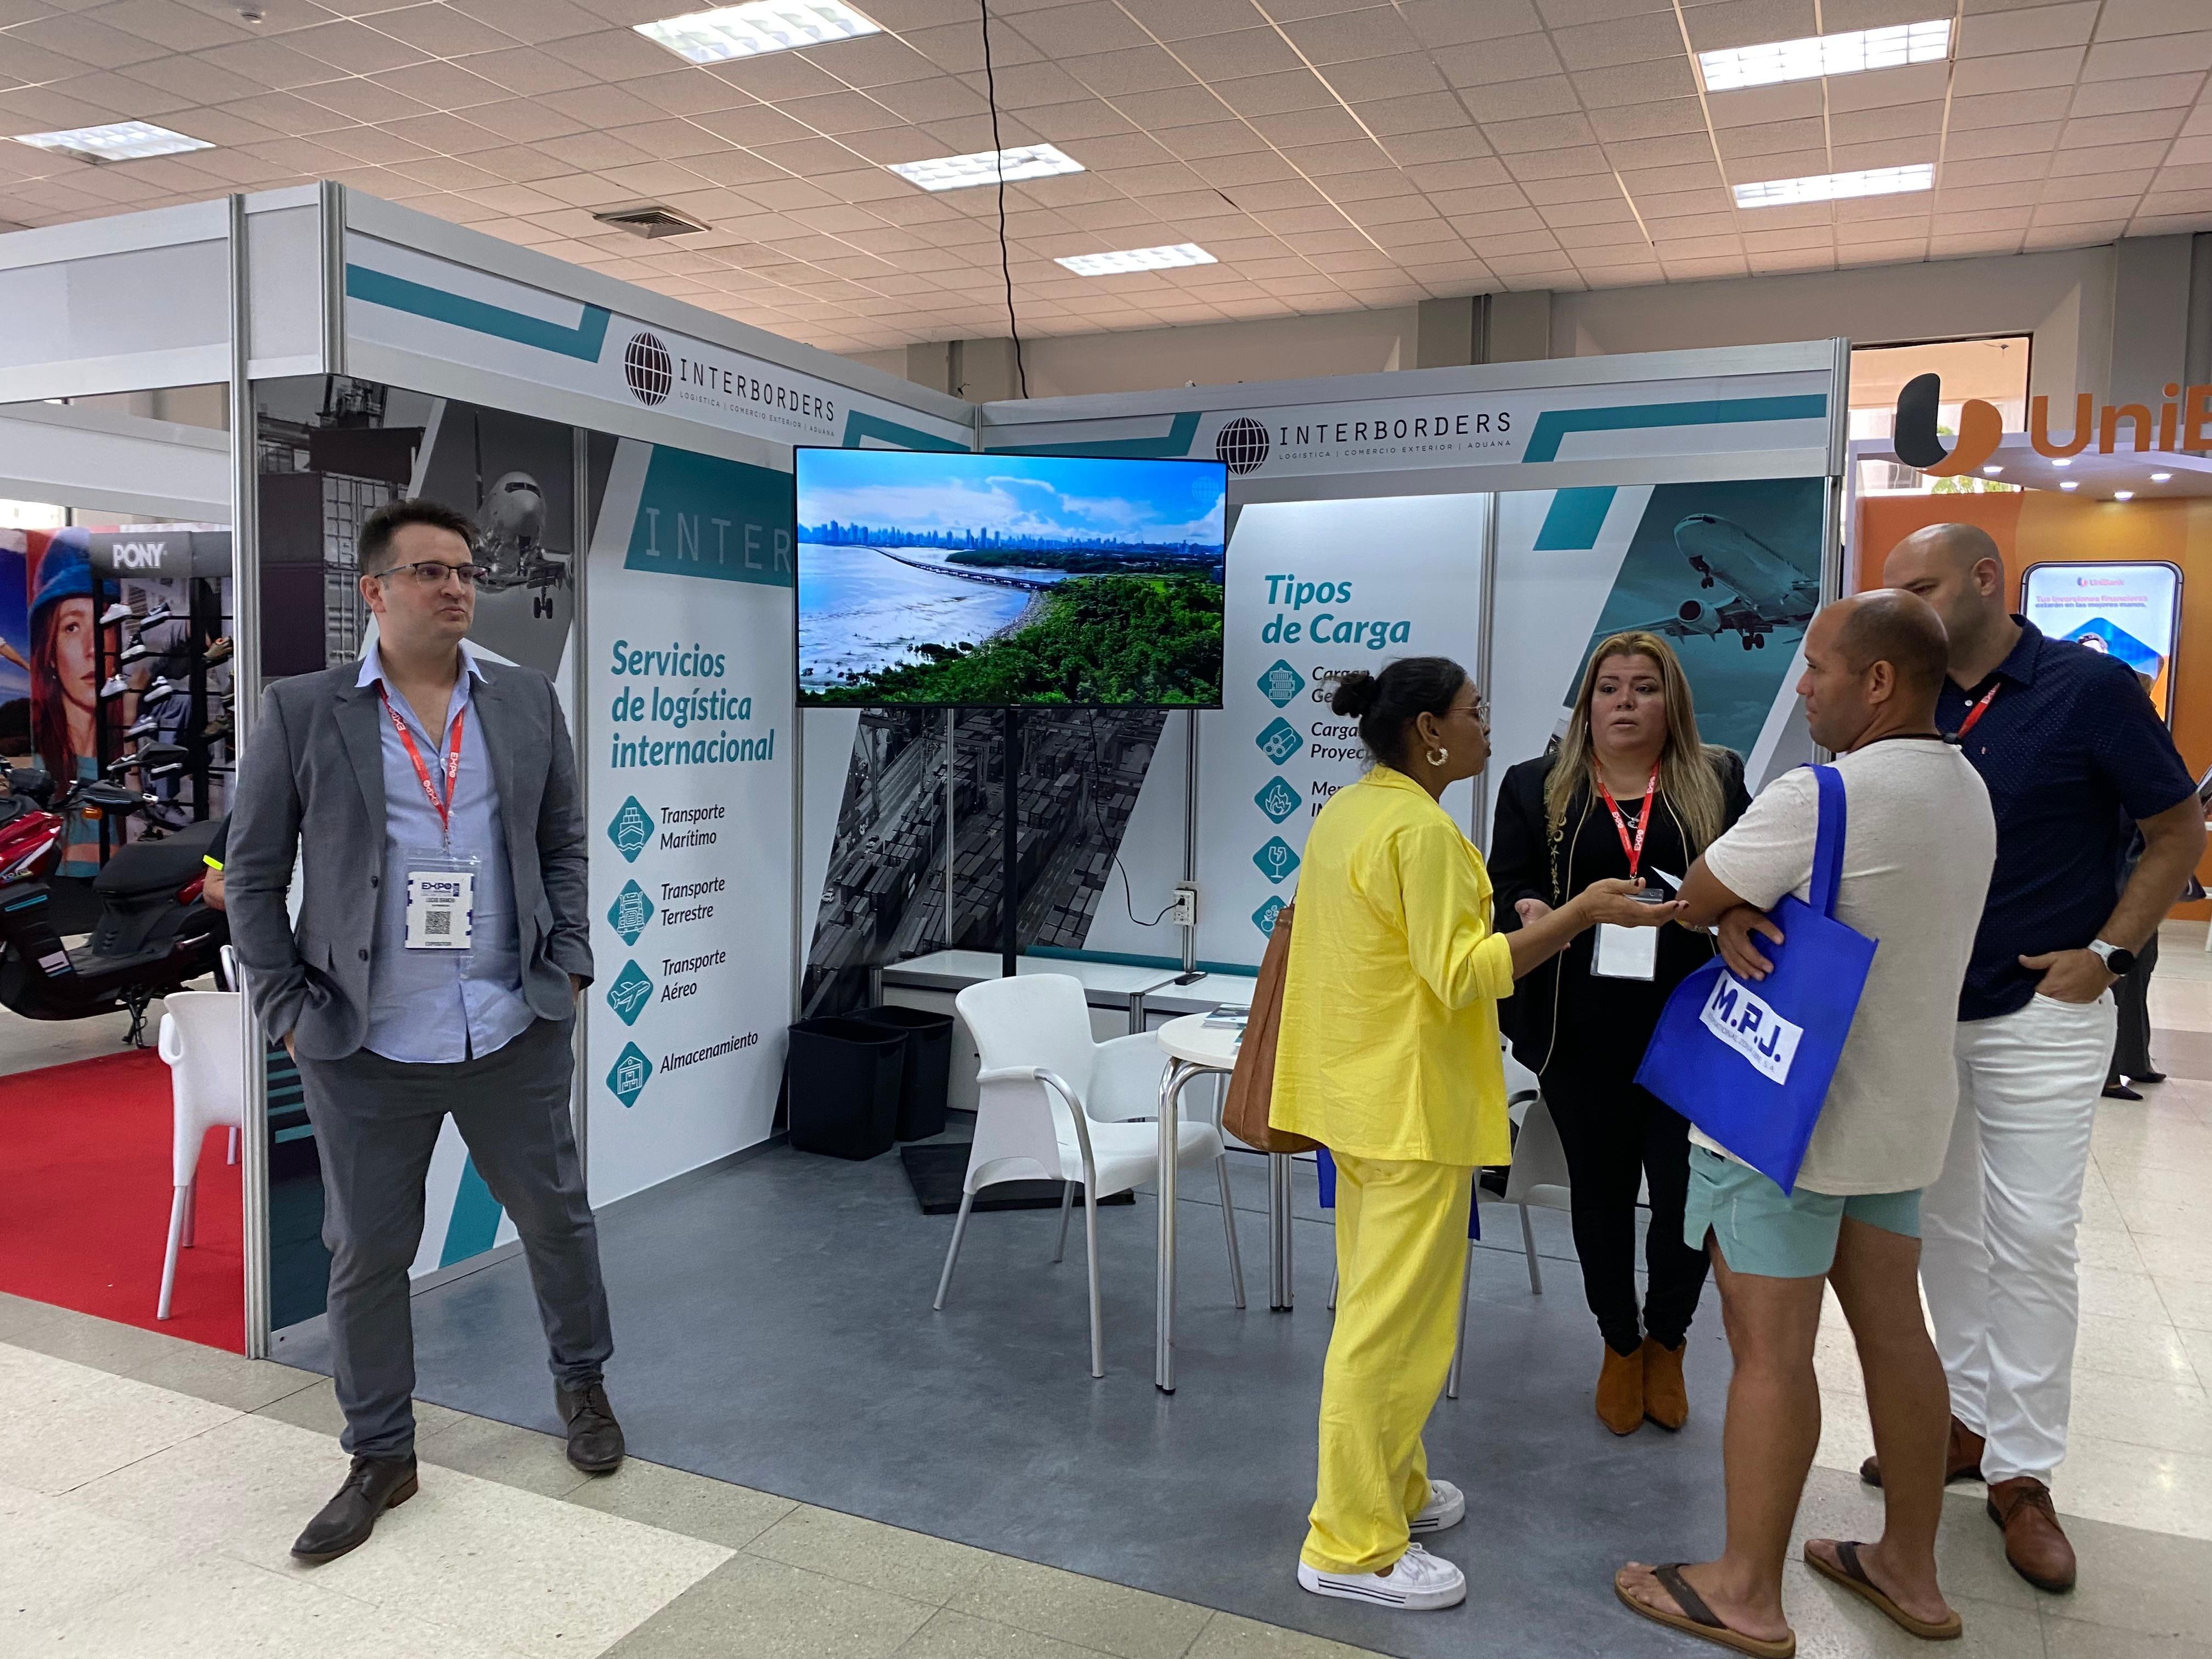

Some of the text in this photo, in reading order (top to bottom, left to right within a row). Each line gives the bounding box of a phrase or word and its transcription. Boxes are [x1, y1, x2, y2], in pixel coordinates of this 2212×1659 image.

[680, 358, 834, 421] INTERBORDERS
[679, 391, 834, 437] LOGISTICA COMERCIO EXTERIOR ADUANA
[1279, 411, 1511, 446] INTERBORDERS
[1279, 439, 1511, 460] LOGISTICA COMERCIO EXTERIOR ADUANA
[645, 506, 792, 574] INTER
[112, 542, 165, 569] PONY
[1264, 573, 1353, 611] Tipos
[1261, 613, 1411, 650] de Carga
[611, 639, 726, 678] Servicios
[611, 685, 752, 729] de logística
[1311, 721, 1358, 741] Carga
[611, 728, 775, 768] internacional
[449, 752, 459, 778] EXPO
[423, 779, 439, 806] EXPO
[661, 804, 725, 825] Transporte
[1612, 811, 1624, 829] EXPO
[660, 829, 717, 850] Marítimo
[1634, 829, 1645, 851] EXPO
[661, 877, 725, 900] Transporte
[661, 904, 714, 926] Terrestre
[662, 949, 726, 977] Transporte
[660, 981, 697, 1003] Aéreo
[1711, 979, 1781, 1063] M.P.J.
[659, 1031, 758, 1074] Almacenamiento
